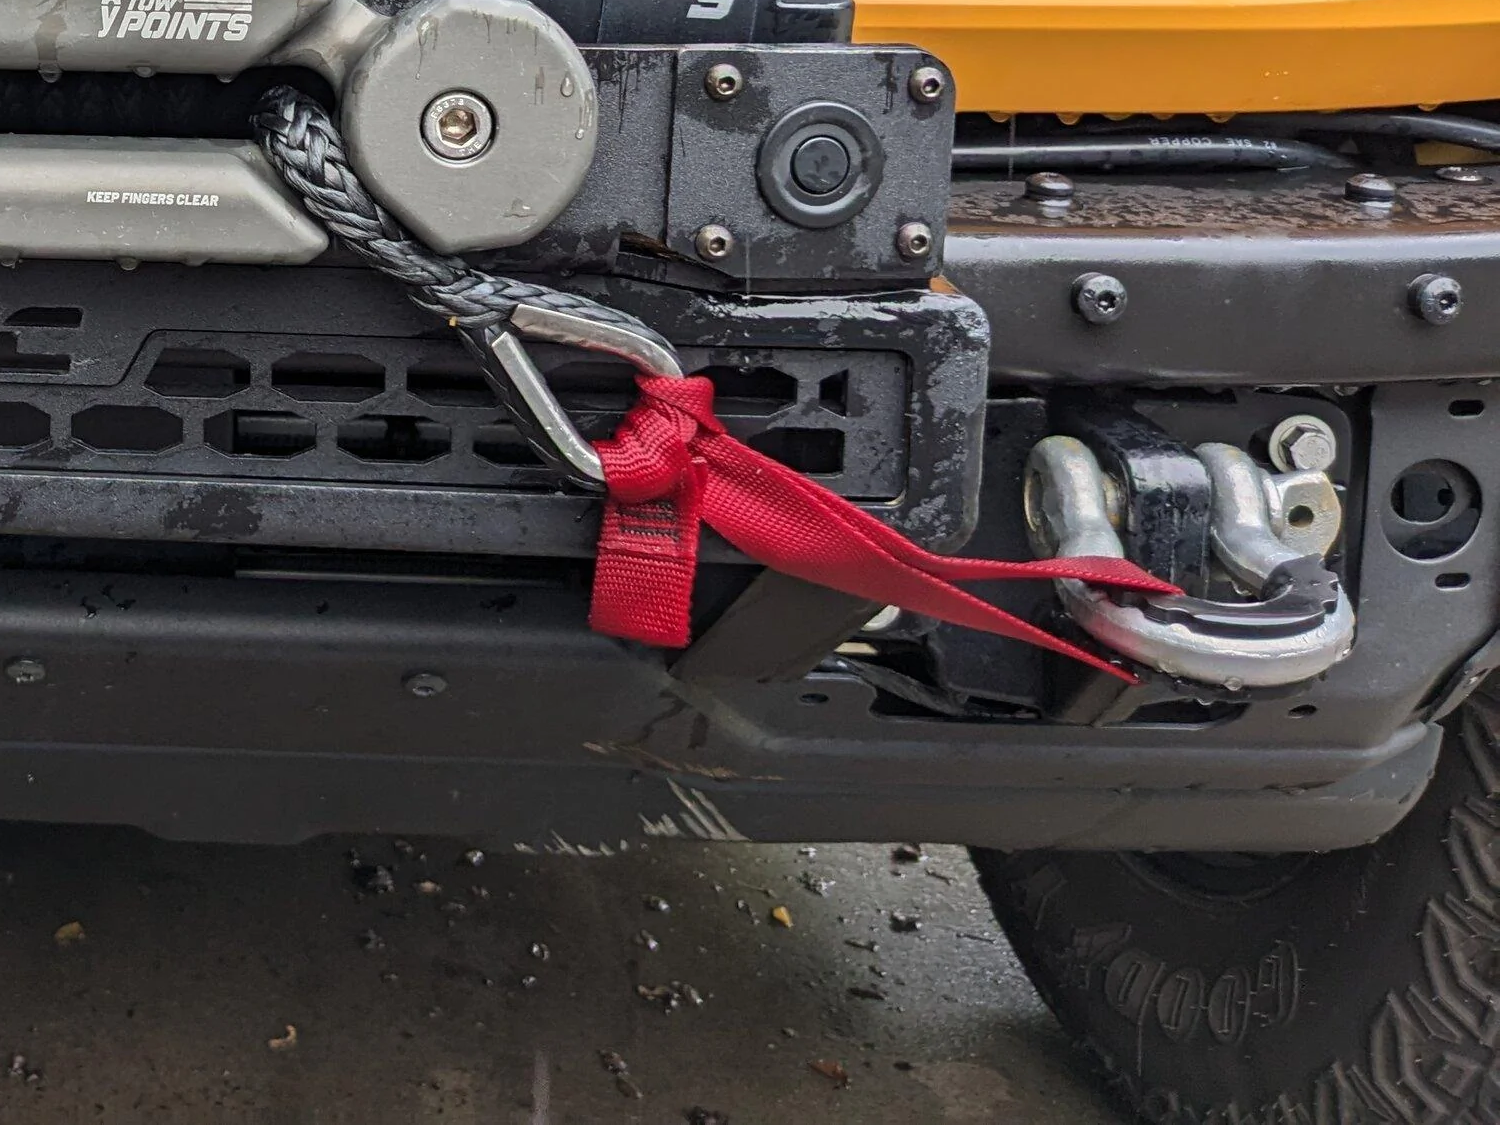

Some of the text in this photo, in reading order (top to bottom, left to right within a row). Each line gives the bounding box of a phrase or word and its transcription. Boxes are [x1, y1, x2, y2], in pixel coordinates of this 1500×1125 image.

[116, 10, 253, 42] POINTS
[1148, 136, 1212, 147] COPPER
[86, 191, 220, 207] KEEP FINGERS CLEAR
